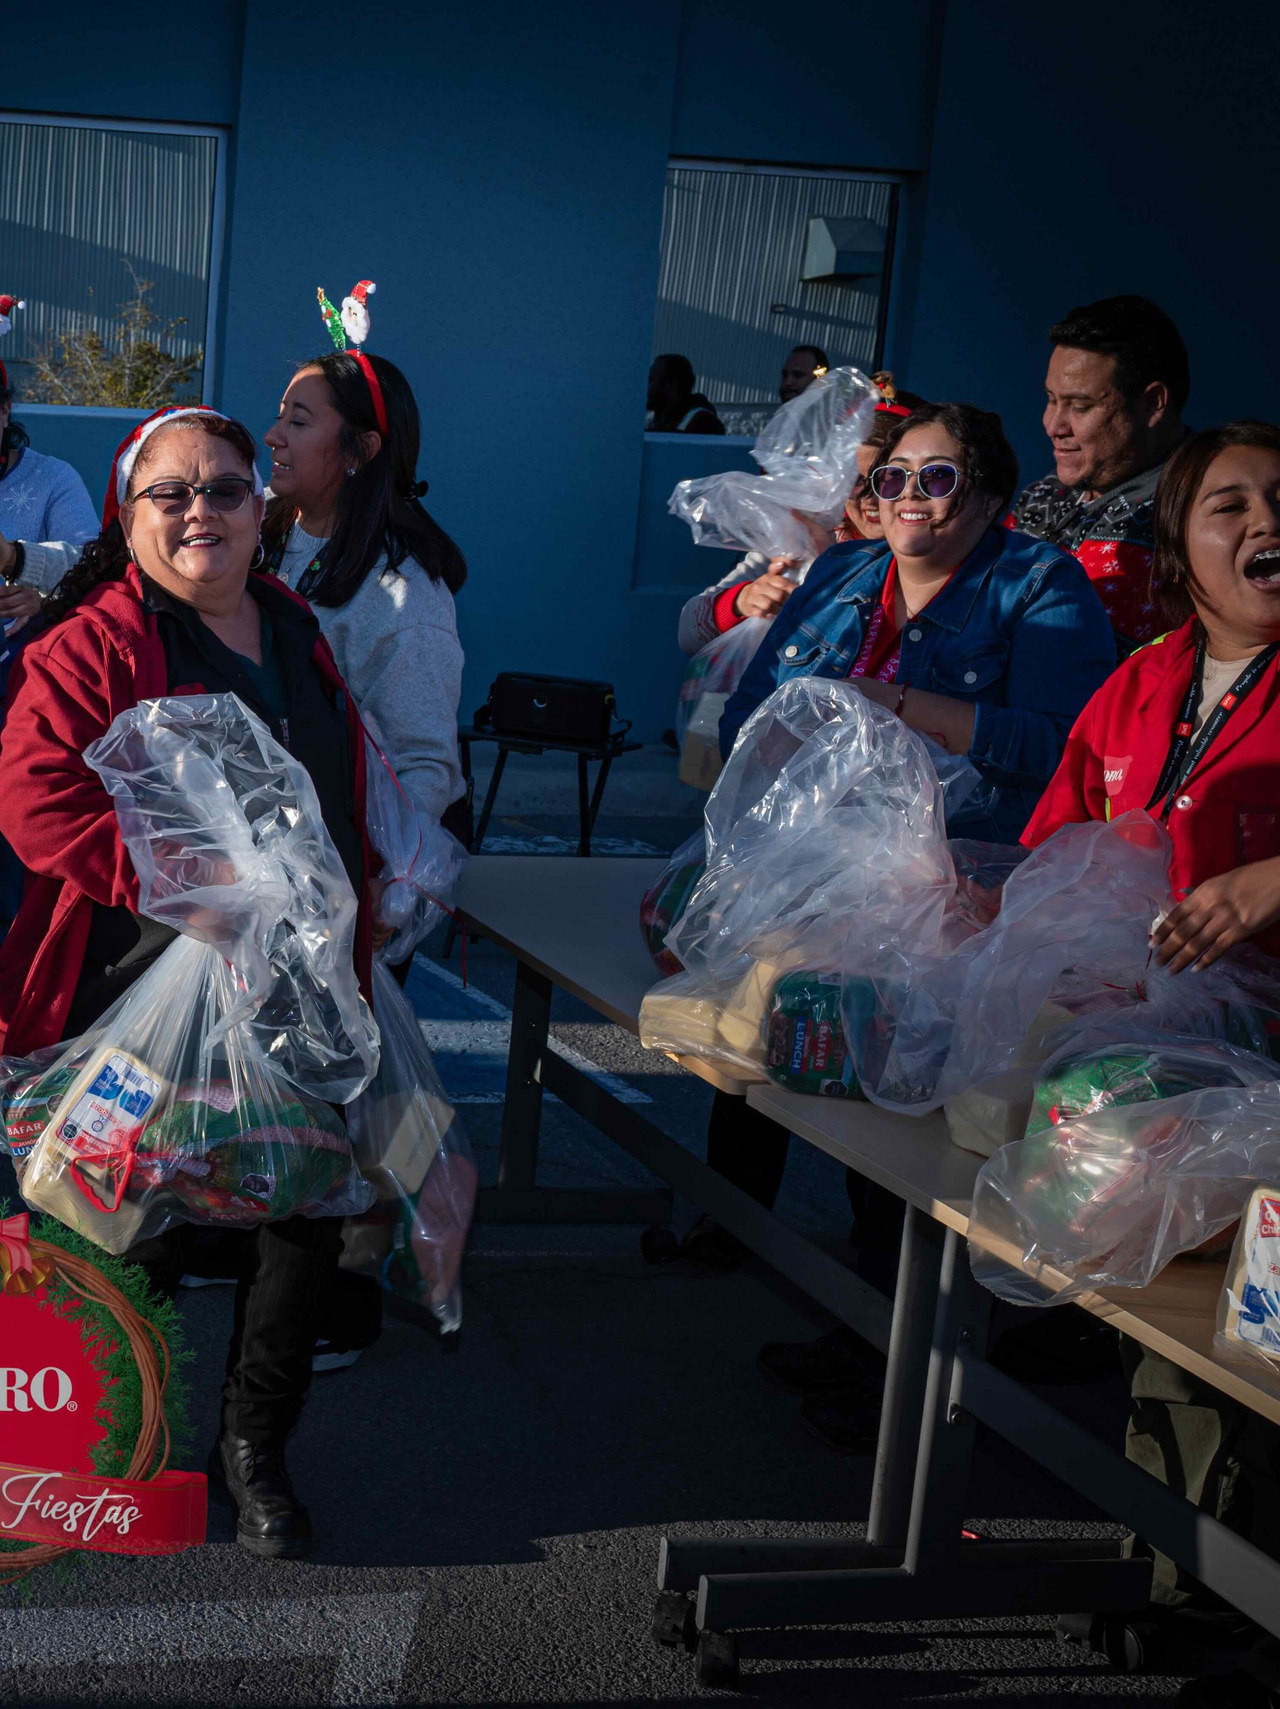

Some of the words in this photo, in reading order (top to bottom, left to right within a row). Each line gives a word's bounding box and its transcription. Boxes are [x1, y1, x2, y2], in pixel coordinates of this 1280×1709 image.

[793, 1022, 806, 1069] LUNCH
[816, 1025, 829, 1068] BAFAR
[7, 1123, 42, 1136] BAFAR
